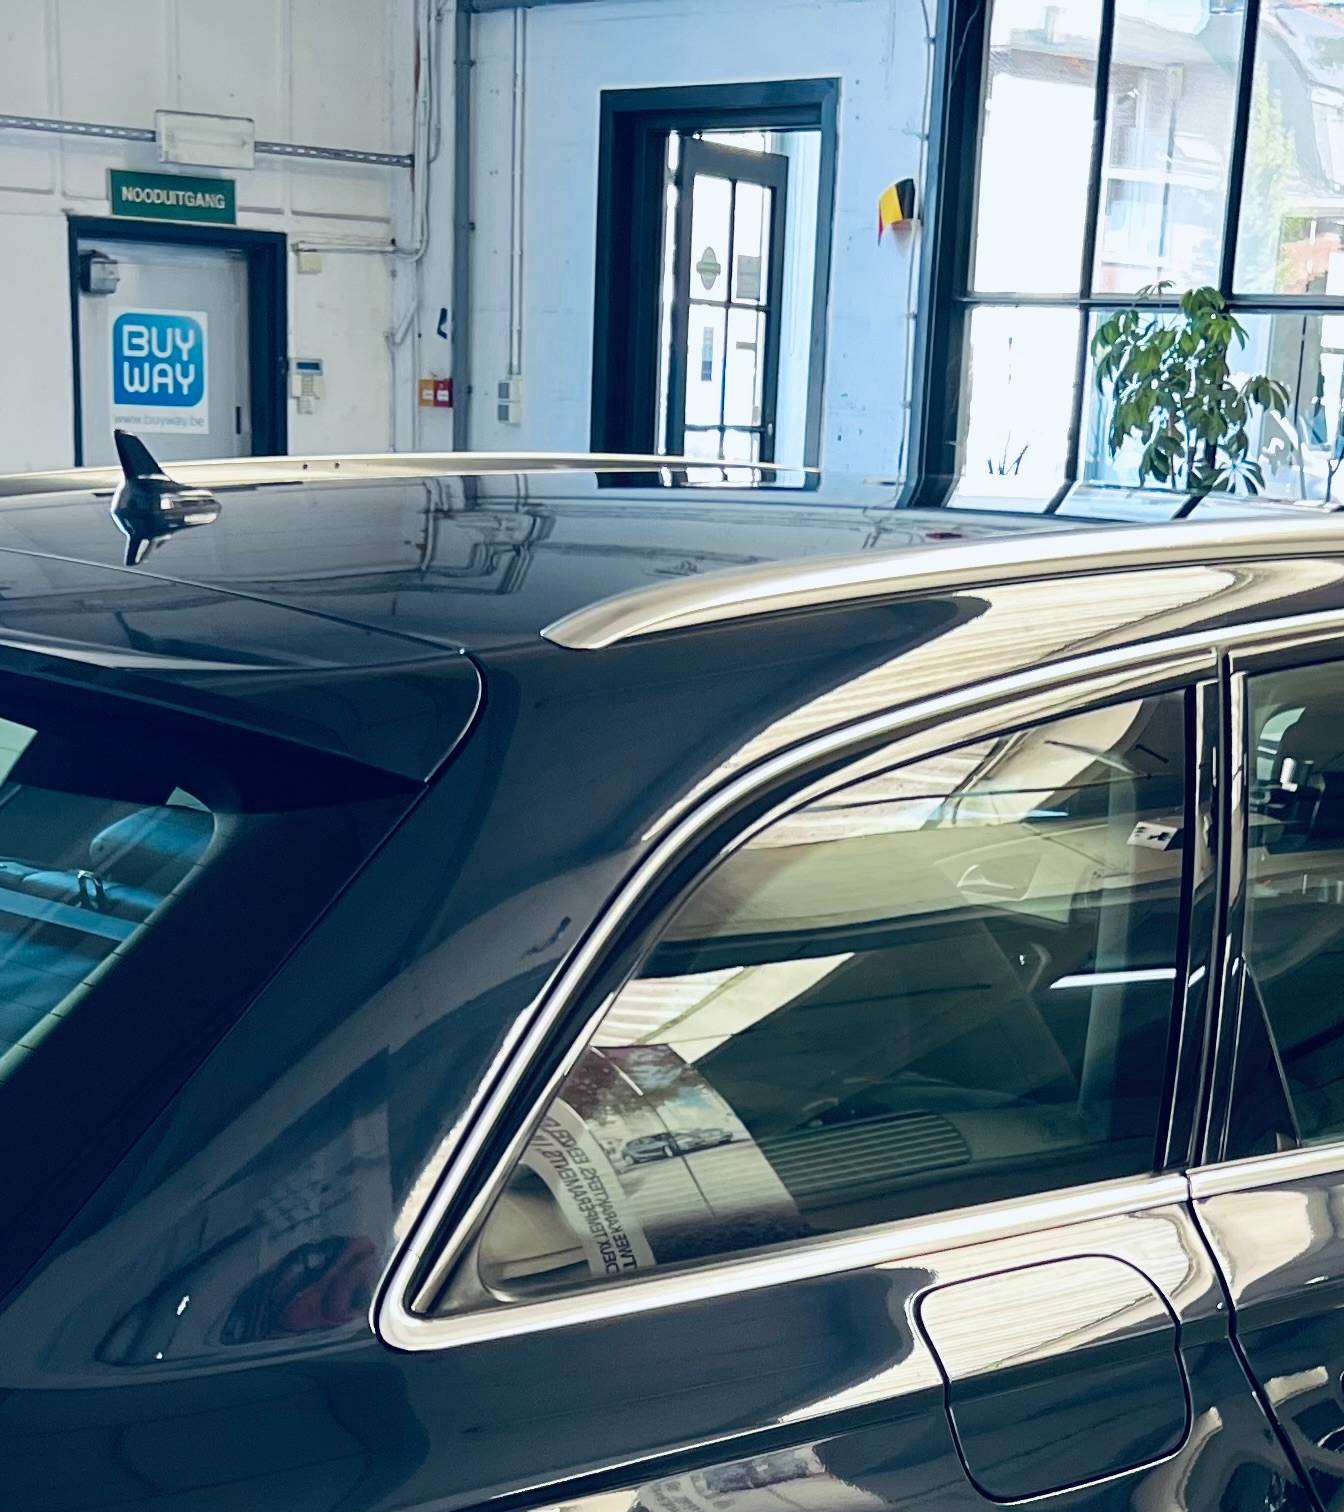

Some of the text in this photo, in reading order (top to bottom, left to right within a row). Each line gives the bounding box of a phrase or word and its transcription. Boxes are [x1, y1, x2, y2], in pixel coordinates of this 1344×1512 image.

[121, 185, 227, 210] NOODUITGANG
[122, 323, 196, 362] BUY
[123, 361, 196, 396] WAY
